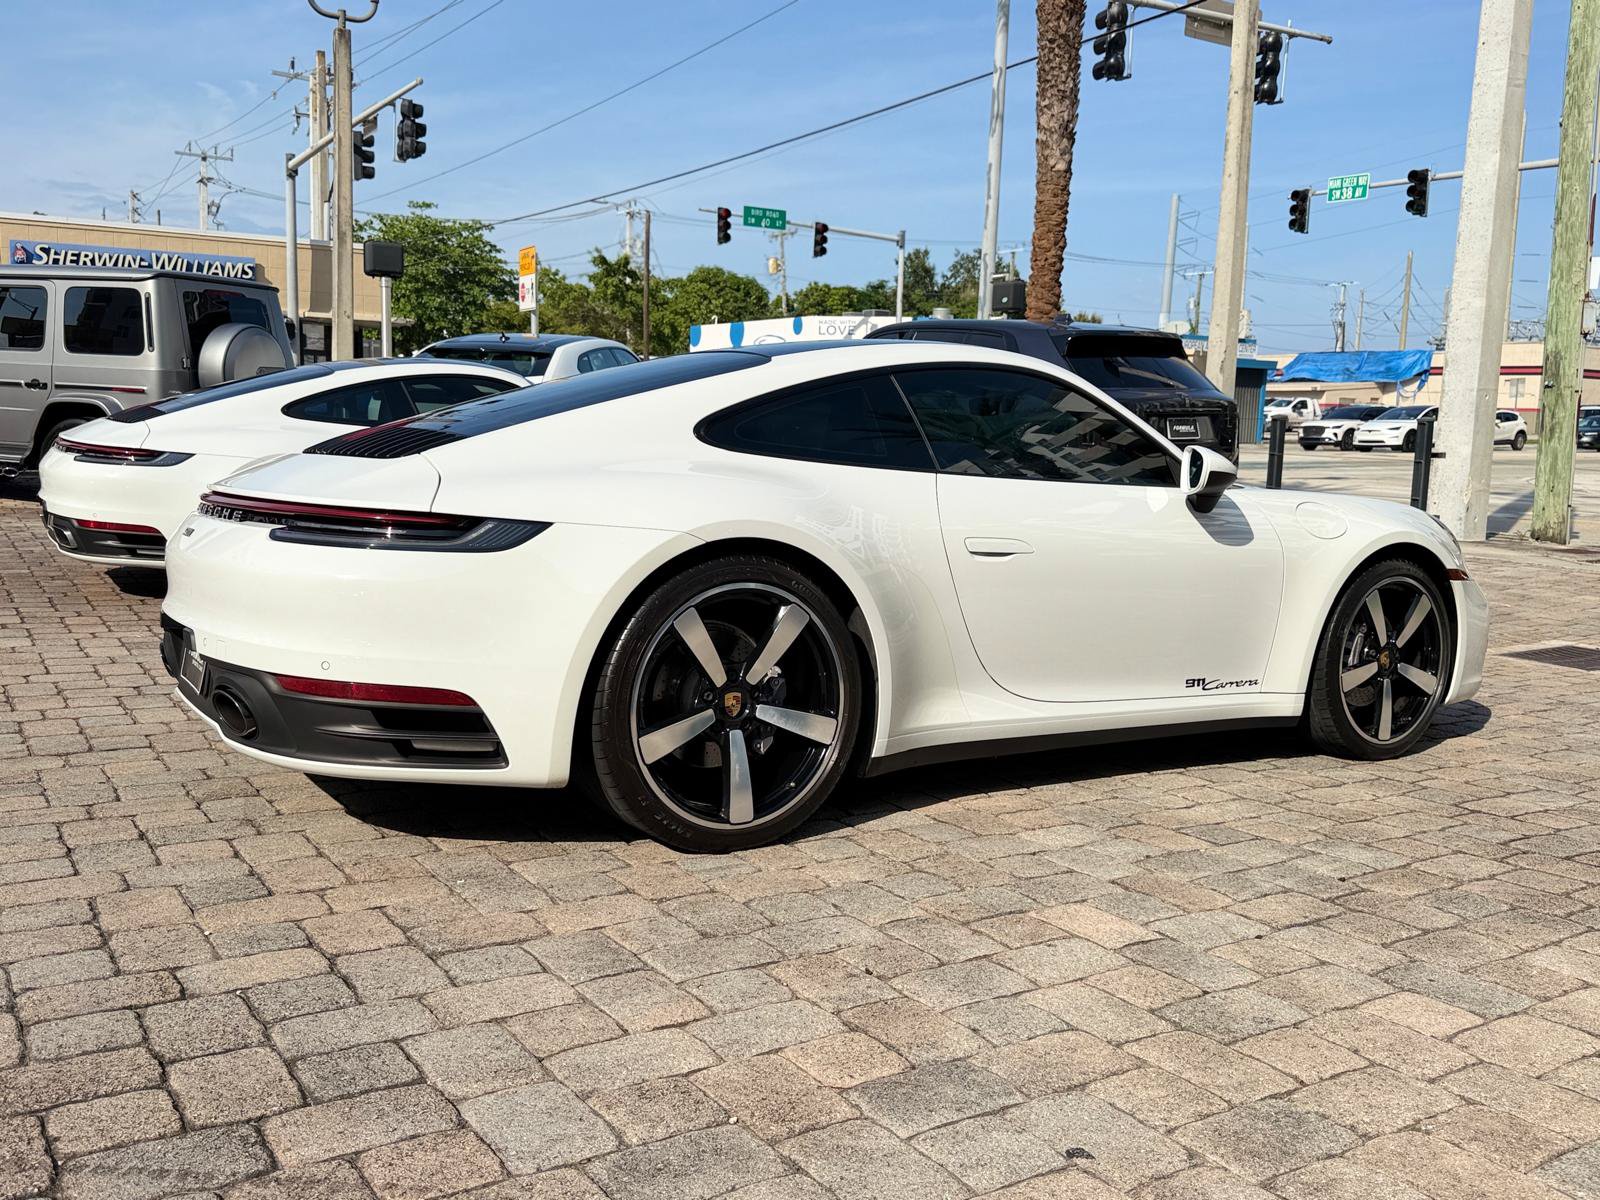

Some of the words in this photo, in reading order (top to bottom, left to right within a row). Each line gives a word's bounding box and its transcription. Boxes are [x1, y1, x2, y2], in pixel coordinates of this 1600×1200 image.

[1343, 177, 1357, 186] GREEN
[1332, 190, 1341, 200] SW
[1341, 187, 1353, 200] 38
[760, 218, 771, 227] 40
[32, 243, 254, 279] SHERWIN-WILLIAMS
[818, 325, 856, 336] LOVE
[1202, 678, 1259, 691] Carrera
